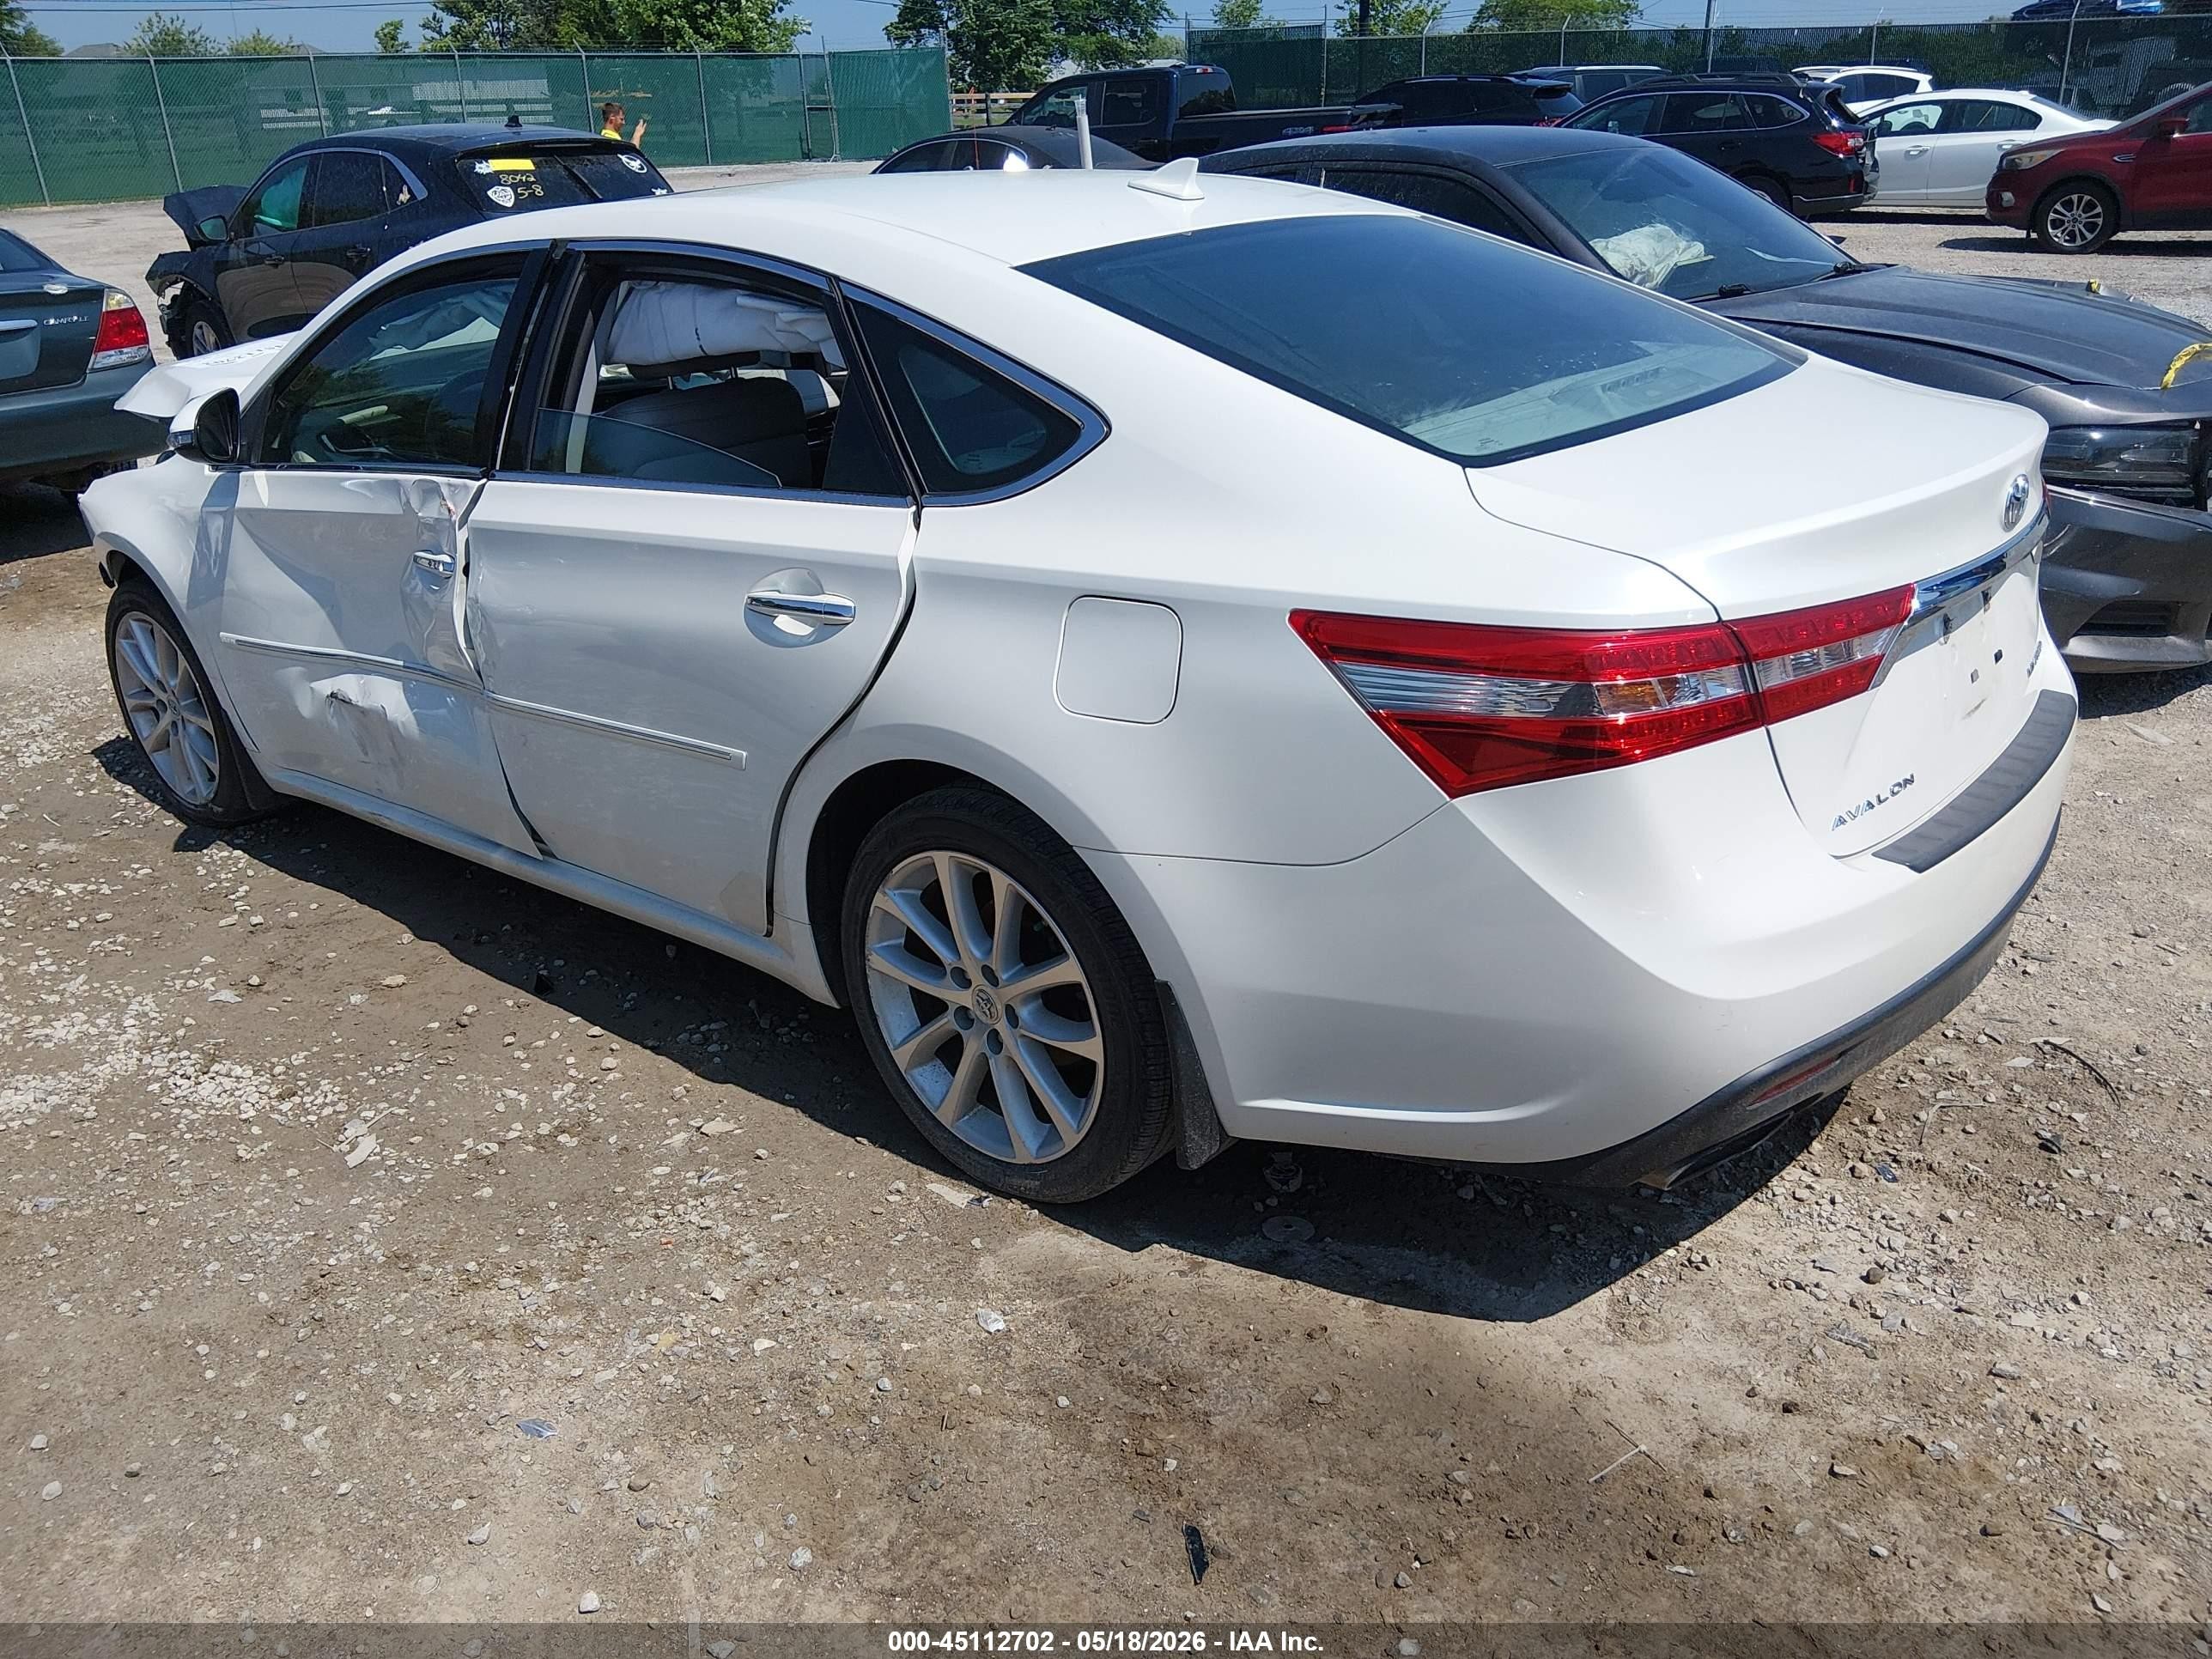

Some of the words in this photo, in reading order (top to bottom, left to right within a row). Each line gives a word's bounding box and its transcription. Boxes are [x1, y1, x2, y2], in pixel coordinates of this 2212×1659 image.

[499, 173, 537, 185] 8042
[517, 184, 544, 199] 5-8
[1832, 773, 1915, 831] AVALON
